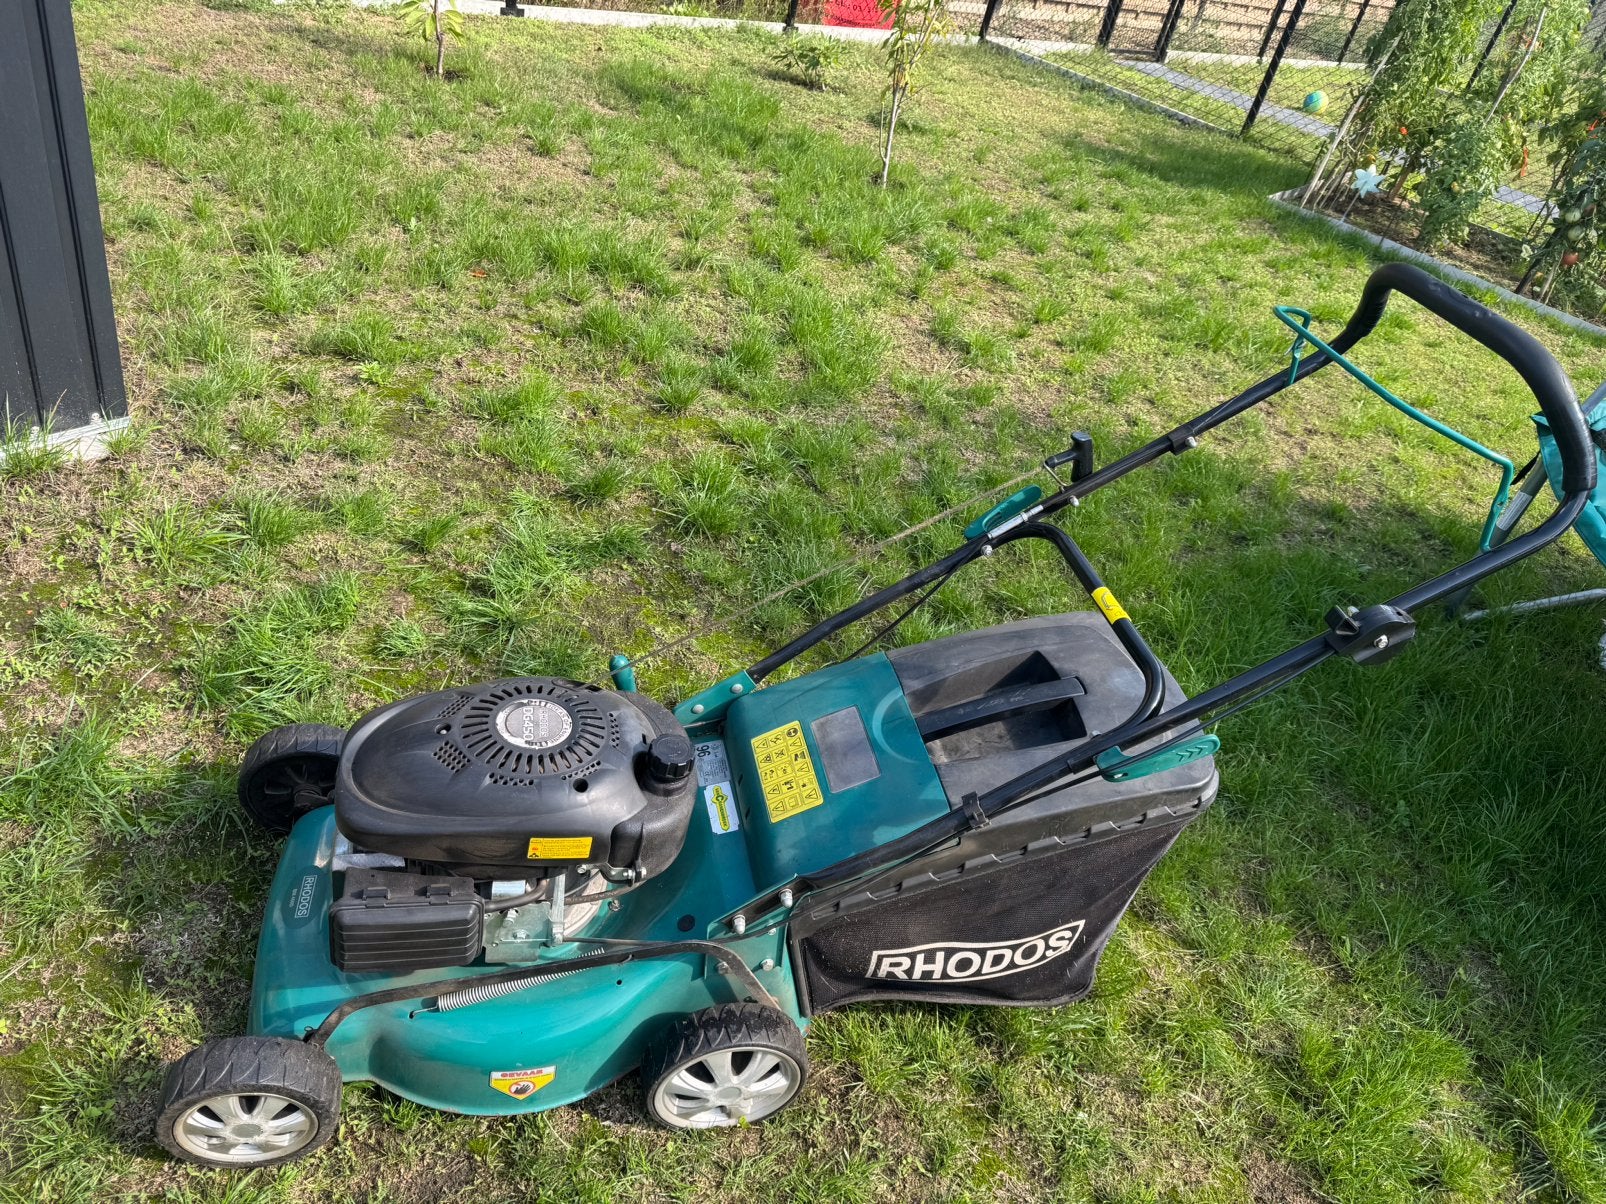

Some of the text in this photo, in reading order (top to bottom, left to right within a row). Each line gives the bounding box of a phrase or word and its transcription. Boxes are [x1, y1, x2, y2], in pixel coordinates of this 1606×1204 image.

[522, 706, 534, 741] DG450
[540, 708, 549, 738] RHODOS
[696, 744, 711, 758] 96
[297, 877, 315, 916] RHODOS
[877, 929, 1073, 980] RHODOS
[500, 1069, 543, 1078] GEVAAR
